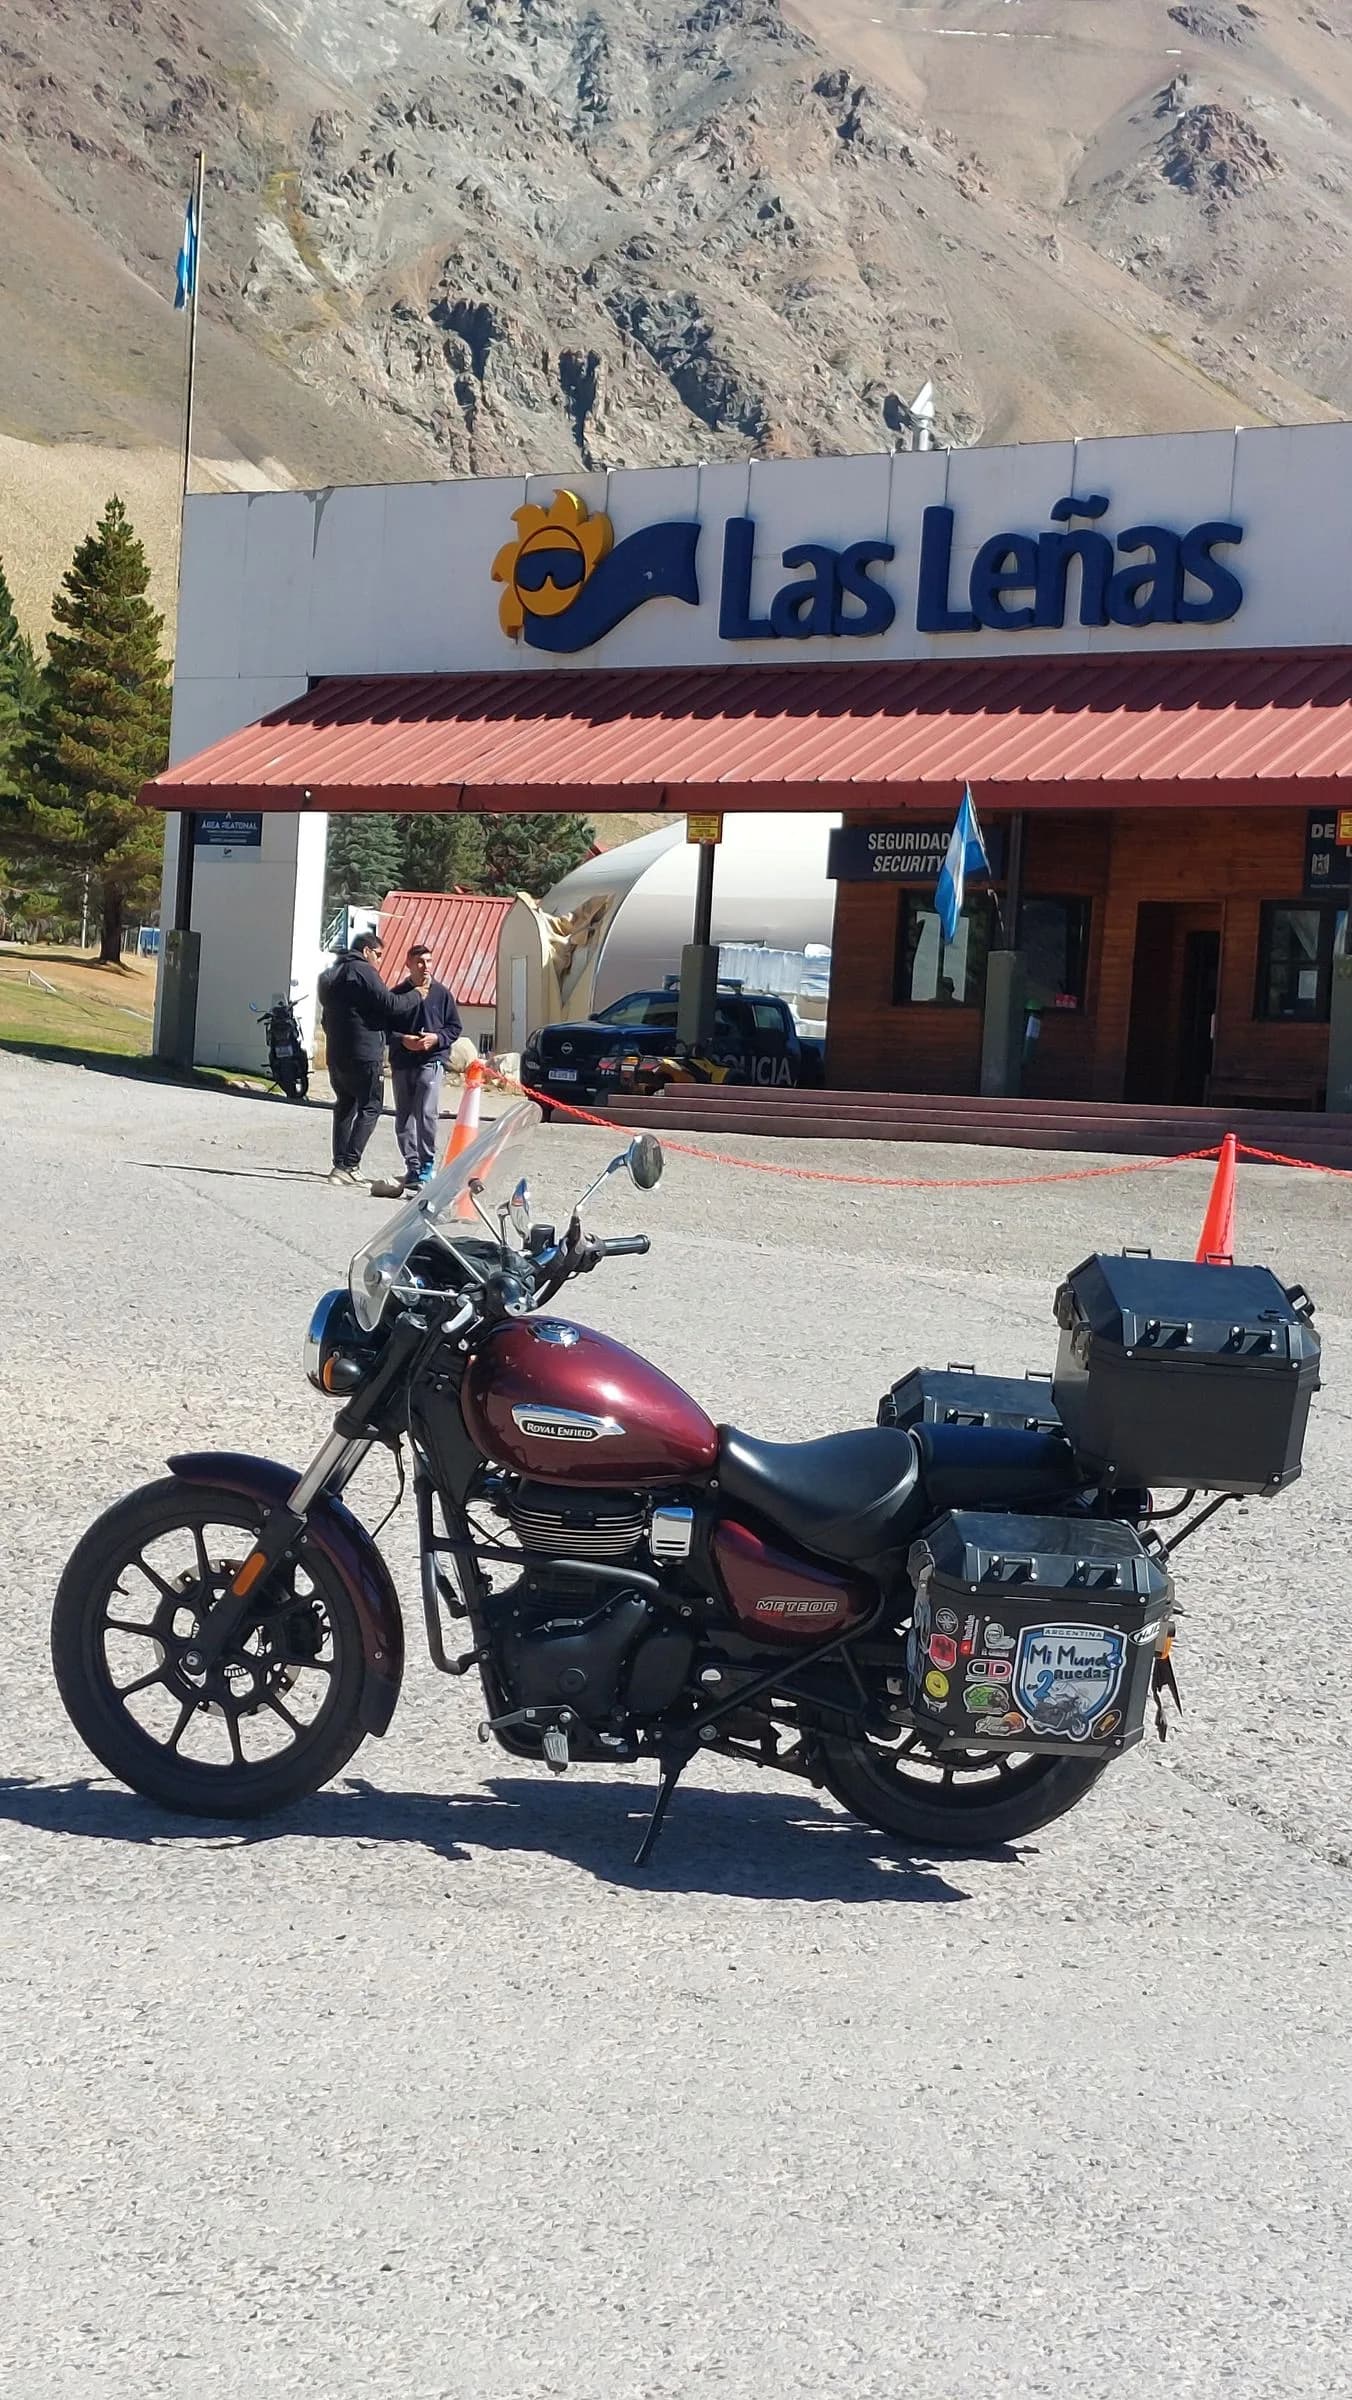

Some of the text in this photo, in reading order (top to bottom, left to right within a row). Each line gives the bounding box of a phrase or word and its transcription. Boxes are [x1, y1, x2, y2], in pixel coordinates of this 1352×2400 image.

[720, 495, 1244, 640] Las Leñas
[868, 832, 950, 850] SEGURIDAD
[872, 855, 946, 873] SECURITY
[526, 1422, 593, 1438] ROYAL ENFIELD
[755, 1600, 838, 1612] METEOR
[1044, 1628, 1103, 1638] ARGENTINA
[1029, 1644, 1052, 1665] Mi
[1032, 1669, 1054, 1700] 2
